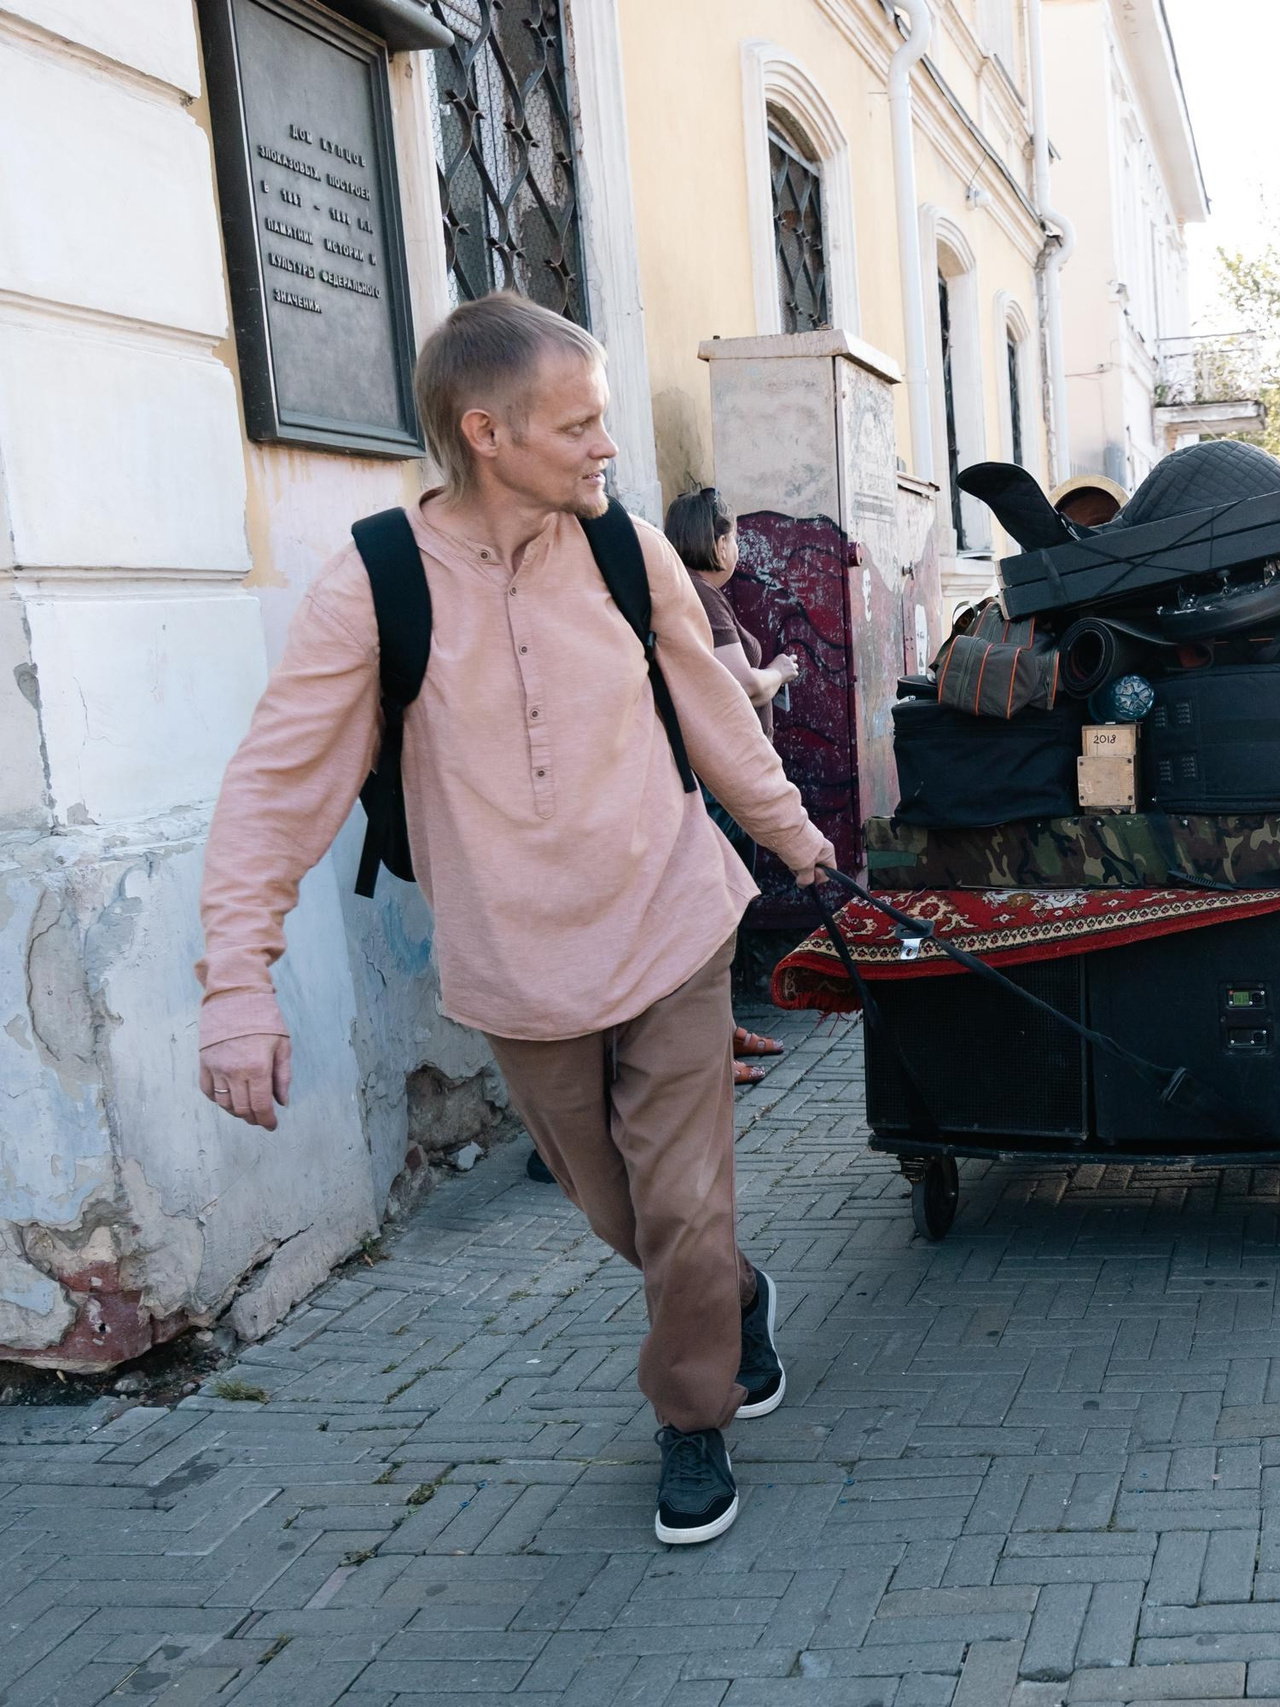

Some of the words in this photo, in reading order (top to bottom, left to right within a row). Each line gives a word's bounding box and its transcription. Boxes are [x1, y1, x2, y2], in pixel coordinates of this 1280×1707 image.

[290, 124, 312, 145] ДОМ
[320, 138, 366, 168] КУПЦОВ
[261, 180, 269, 194] В
[327, 173, 371, 201] ПОСТРОЕН
[265, 217, 313, 246] ПАМЯТНИК
[324, 238, 364, 262] ИСТОРИИ
[369, 253, 377, 266] И
[268, 252, 316, 279] КУЛЬТУРЫ
[319, 269, 381, 299] ФЕДЕРАЛЬНОГО
